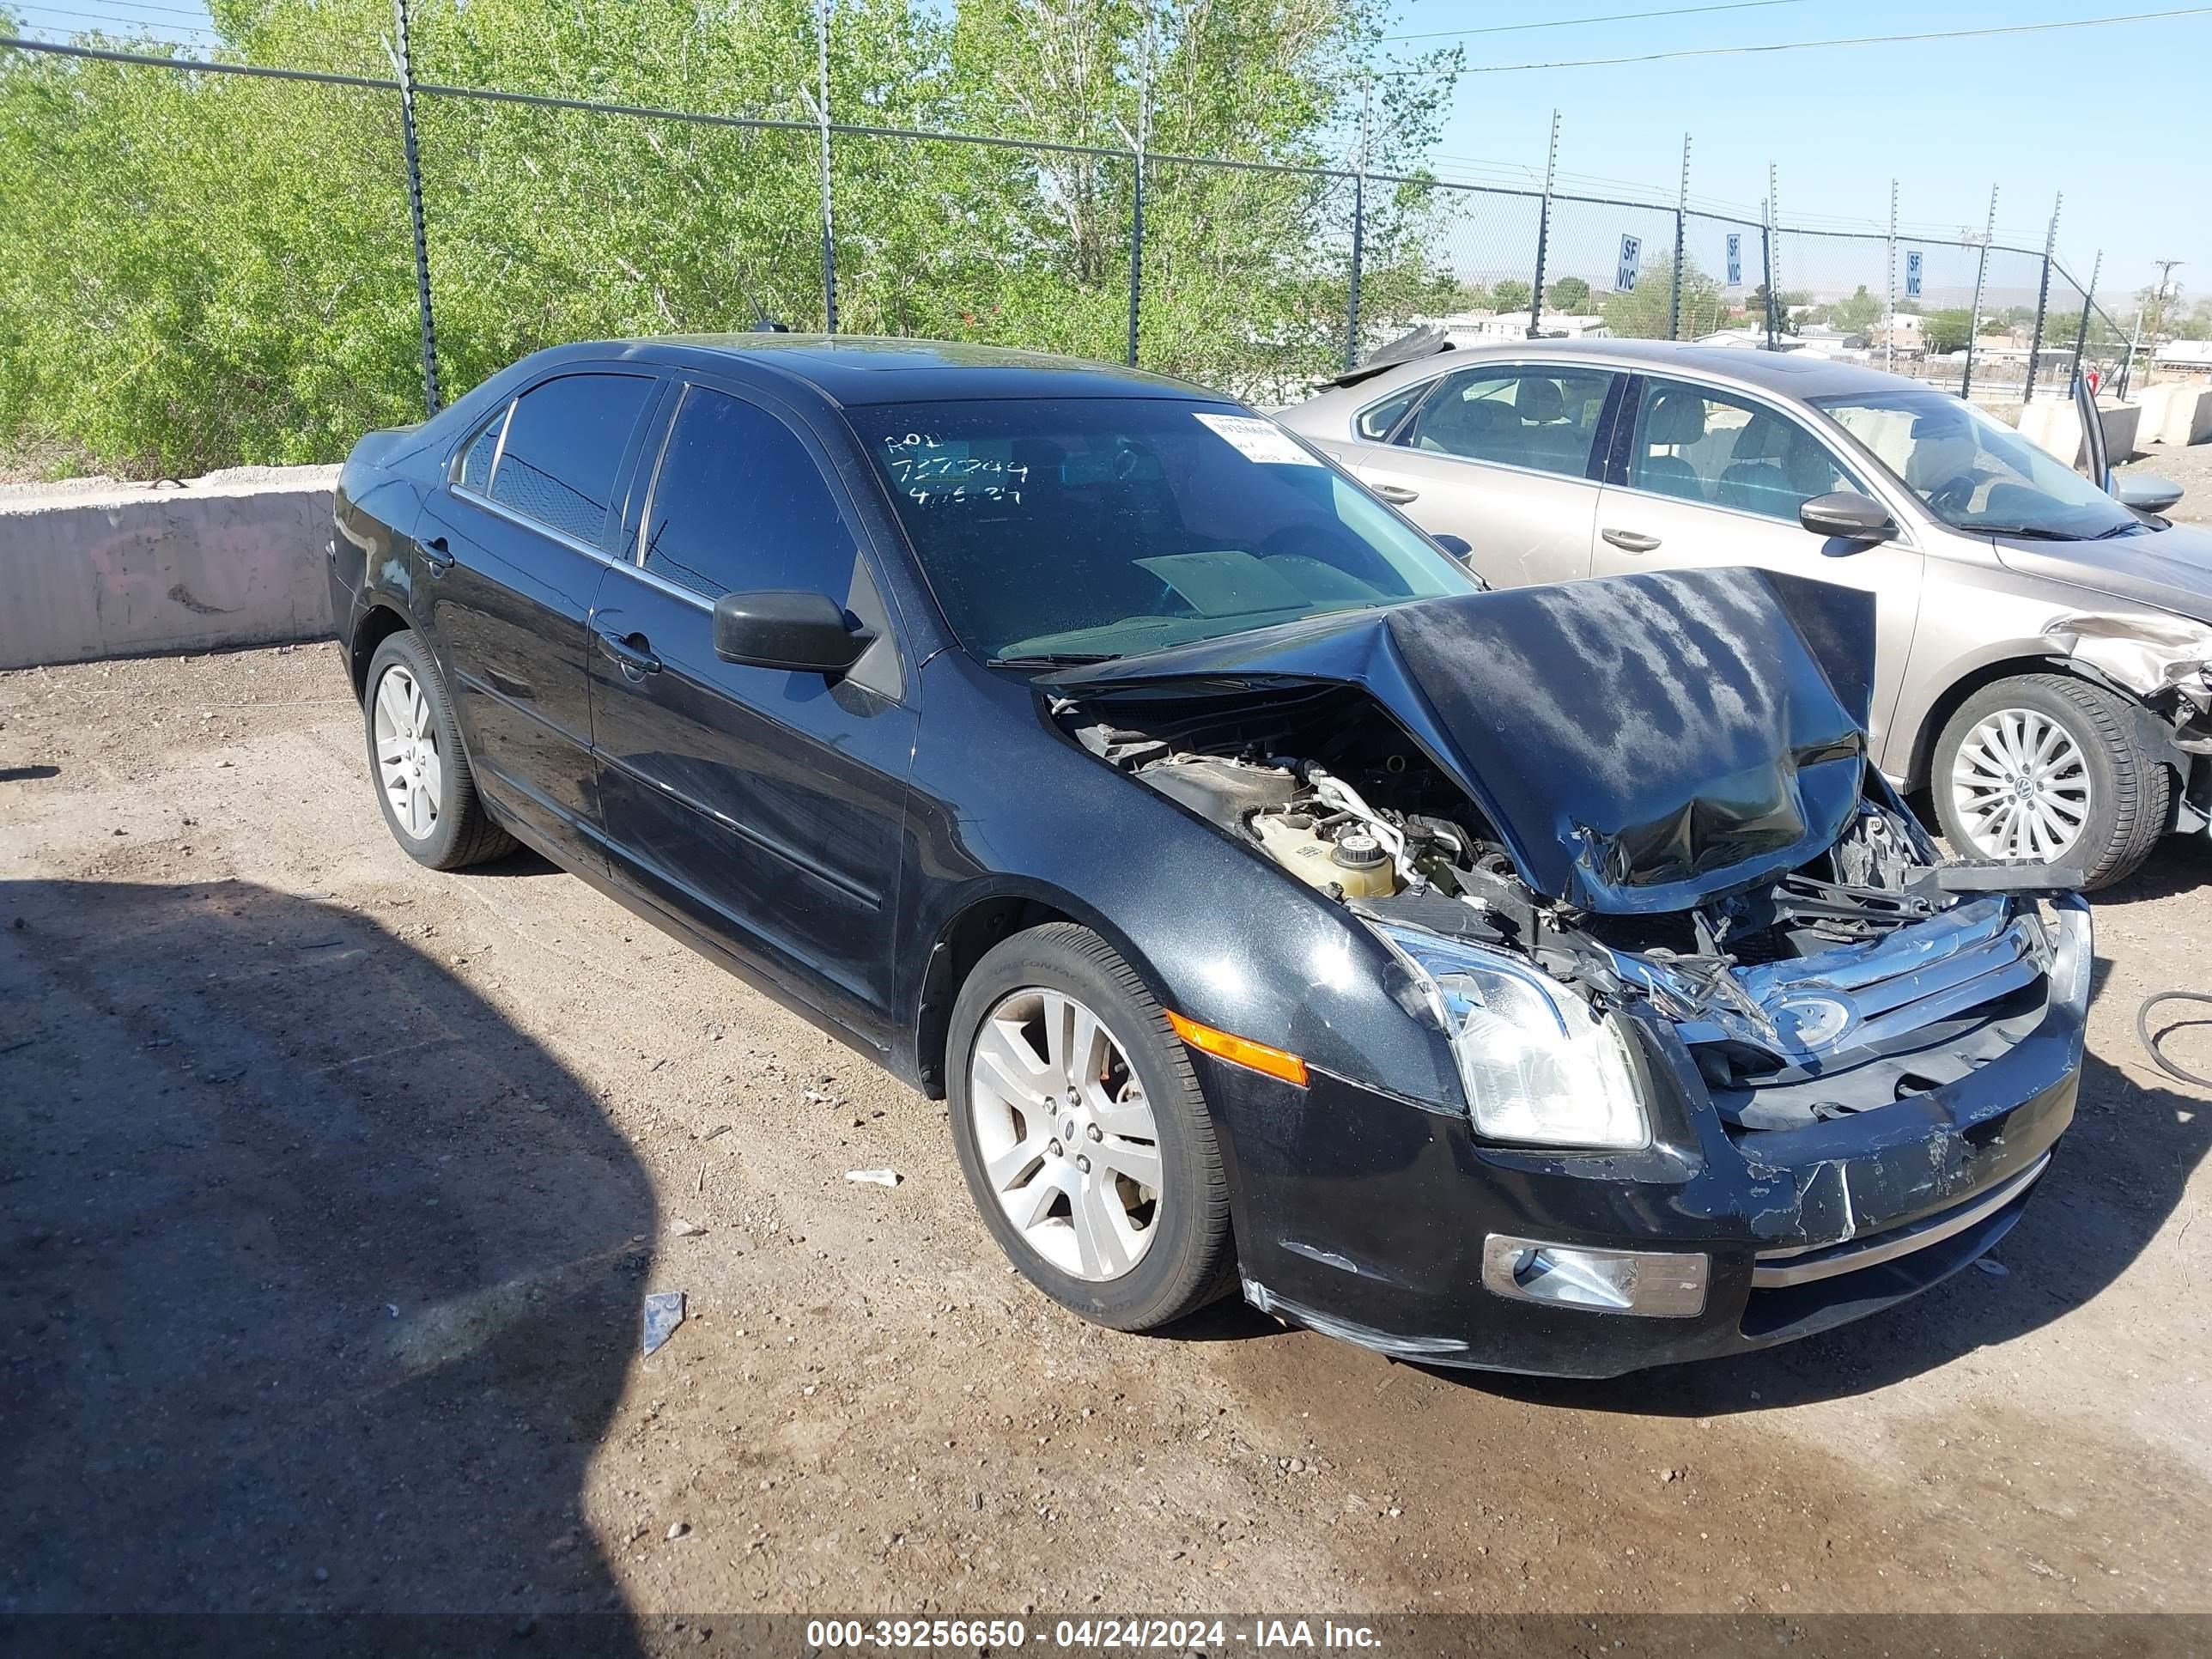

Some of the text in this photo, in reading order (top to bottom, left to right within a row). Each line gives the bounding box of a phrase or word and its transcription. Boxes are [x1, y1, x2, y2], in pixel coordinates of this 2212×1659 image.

[1624, 240, 1638, 262] SF
[1729, 238, 1738, 257] SF
[1910, 255, 1919, 271] SF
[1619, 266, 1636, 290] VIC
[1728, 263, 1741, 283] VIC
[1907, 277, 1920, 294] VIC
